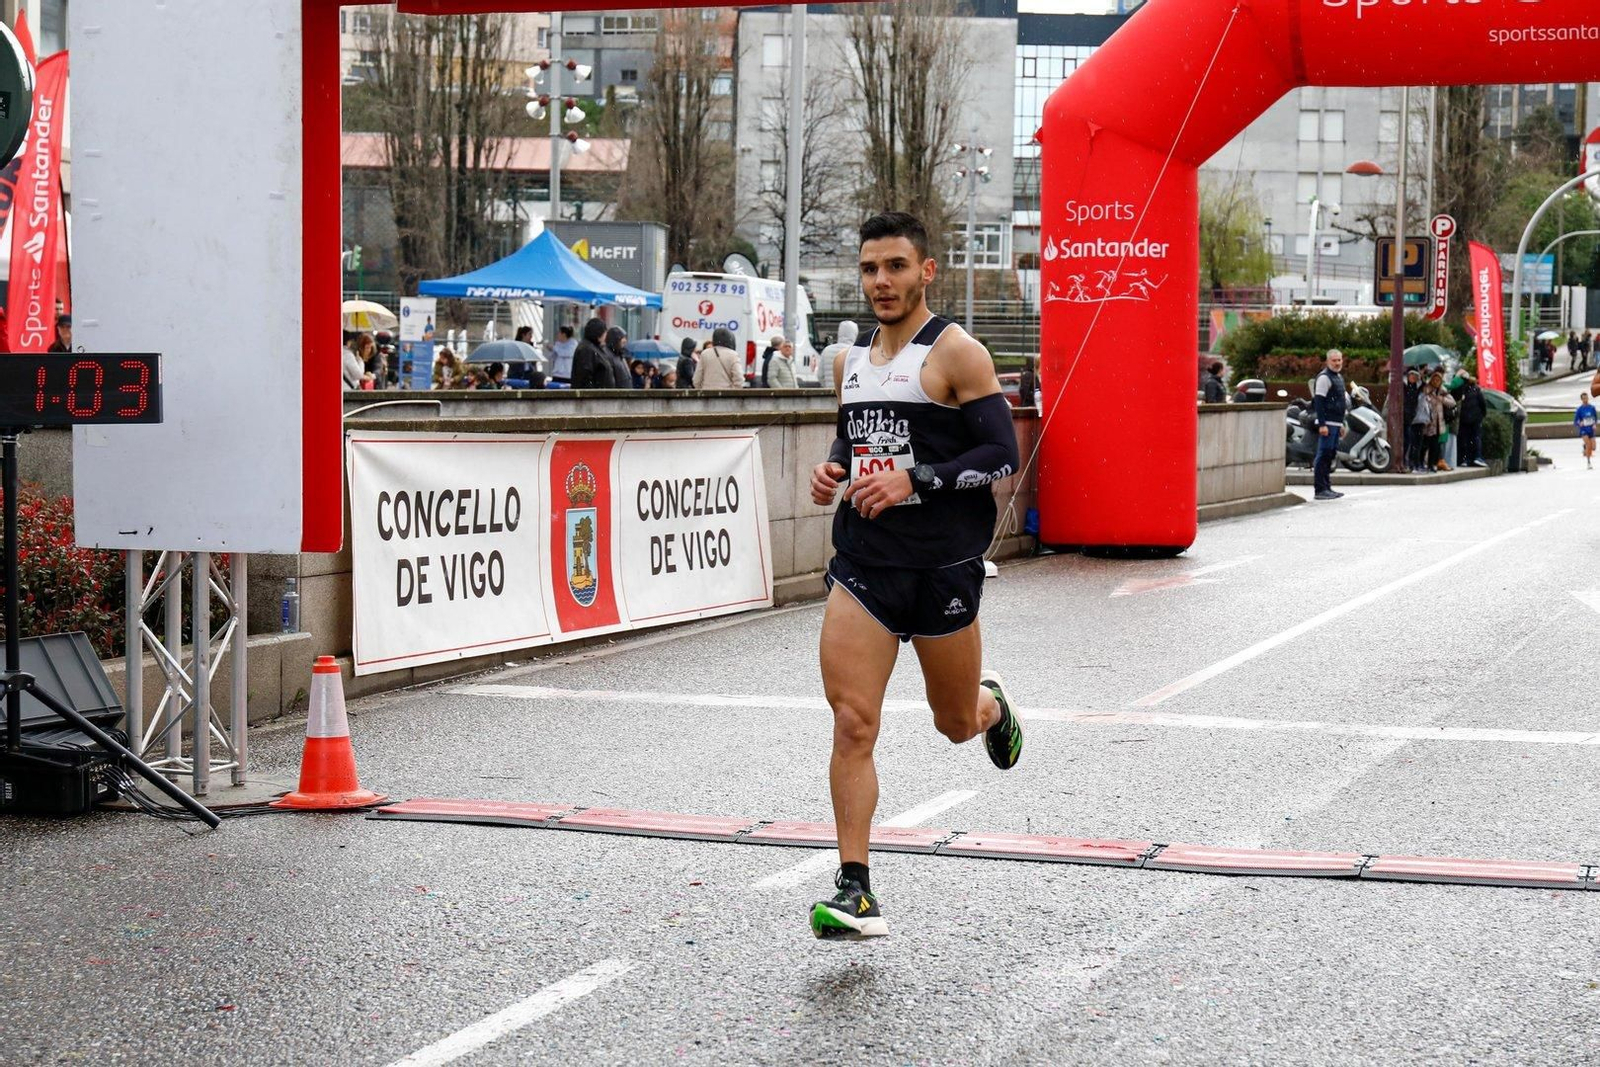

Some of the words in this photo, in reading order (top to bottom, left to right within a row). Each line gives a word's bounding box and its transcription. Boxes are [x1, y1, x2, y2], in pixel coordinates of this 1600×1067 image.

[29, 94, 53, 229] Santander
[1065, 200, 1135, 226] Sports
[1435, 218, 1451, 235] P
[591, 246, 636, 260] McFIT
[1060, 237, 1170, 259] Santander
[1388, 244, 1418, 277] P
[671, 281, 691, 292] 902
[695, 282, 709, 293] 55
[713, 283, 727, 294] 78
[731, 284, 745, 295] 98
[1437, 242, 1447, 307] PARKING
[21, 267, 47, 347] Sports
[847, 408, 911, 440] delikia
[376, 485, 521, 542] CONCELLO
[637, 474, 740, 522] CONCELLO
[650, 534, 677, 576] DE
[681, 527, 731, 571] VIGO
[396, 556, 433, 607] DE
[440, 549, 505, 601] VIGO
